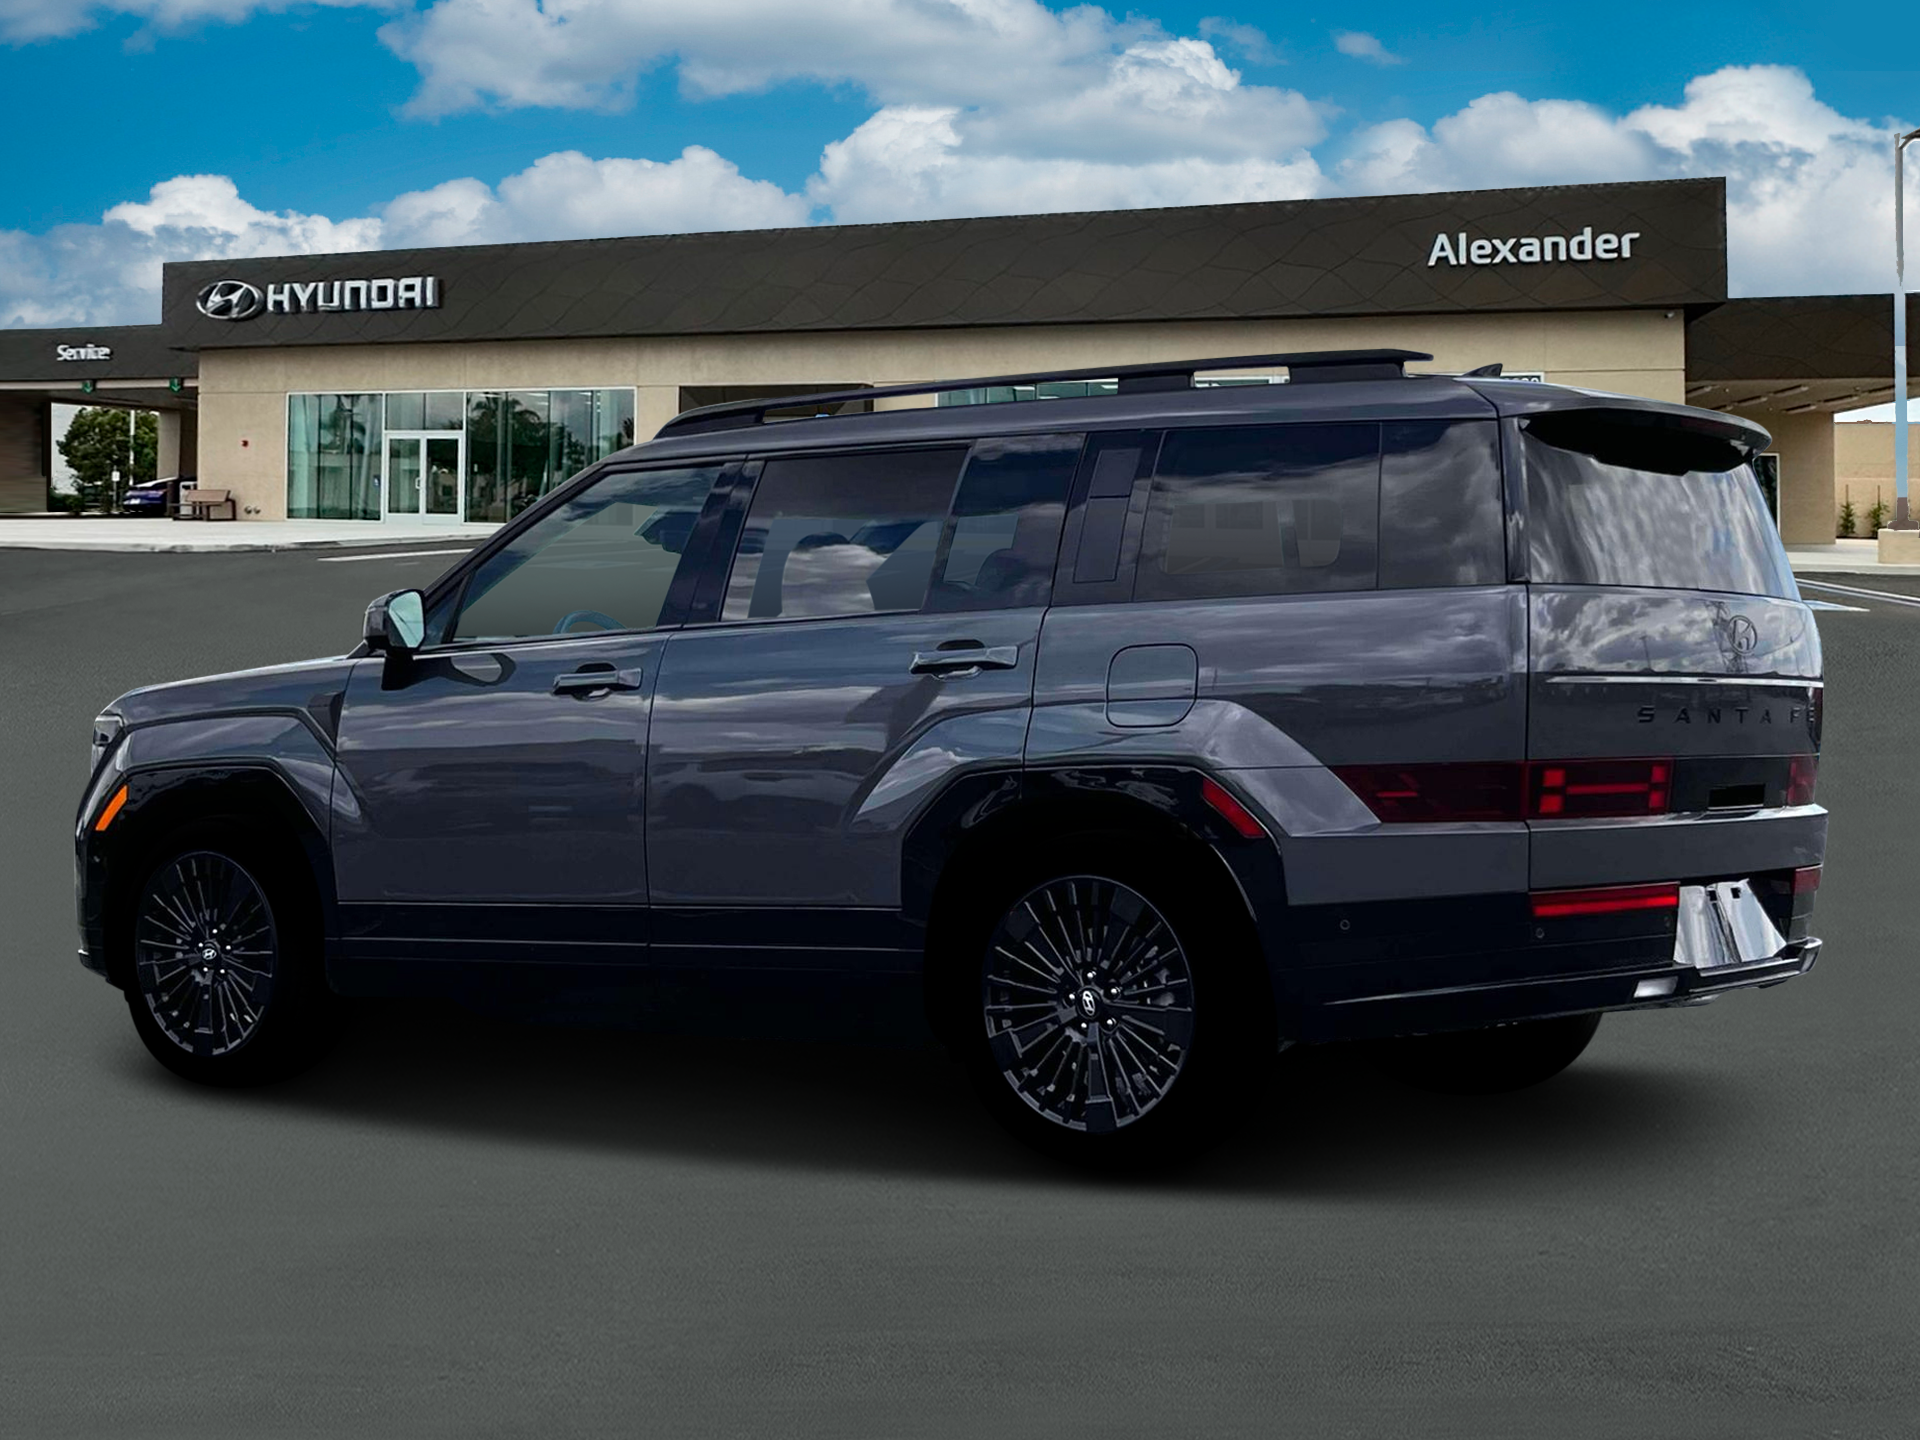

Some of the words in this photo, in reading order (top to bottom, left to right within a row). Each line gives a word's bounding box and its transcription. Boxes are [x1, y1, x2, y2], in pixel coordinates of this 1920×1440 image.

[1427, 226, 1641, 267] Alexander
[266, 276, 438, 314] HYUNDAI
[56, 343, 111, 361] Service
[1637, 705, 1773, 724] SANTA
